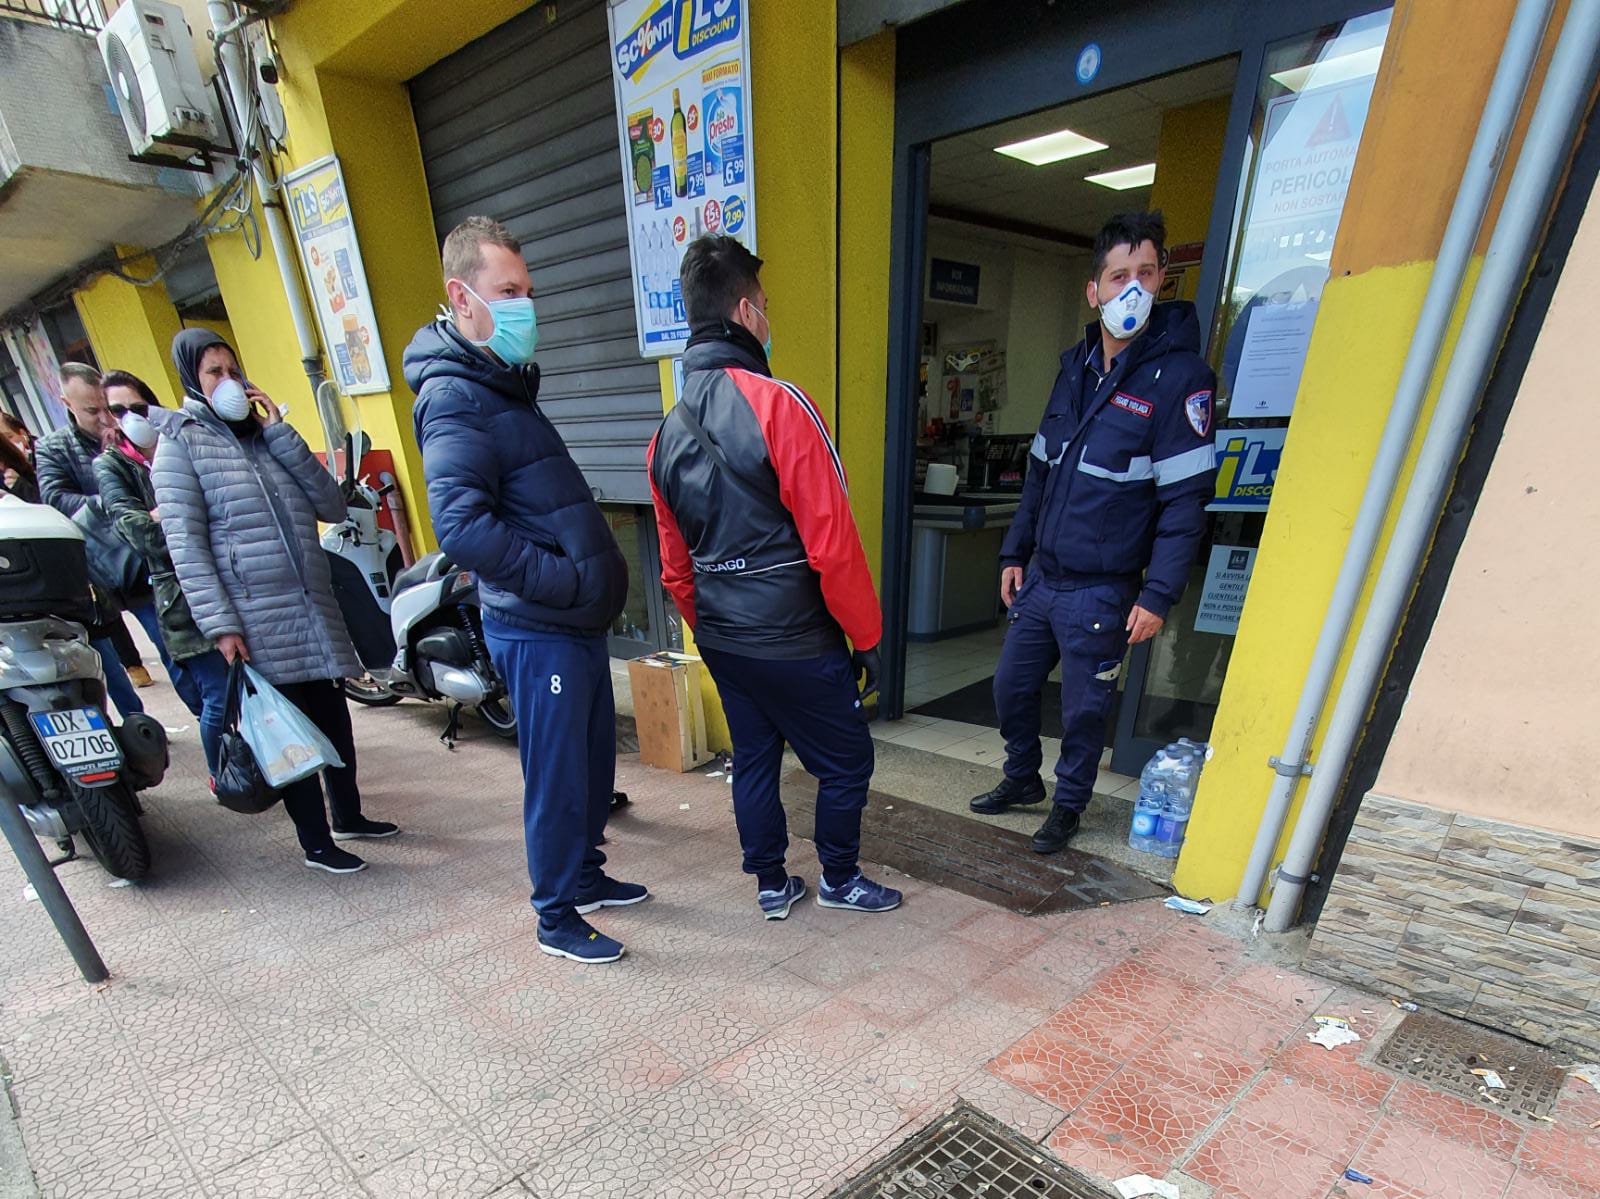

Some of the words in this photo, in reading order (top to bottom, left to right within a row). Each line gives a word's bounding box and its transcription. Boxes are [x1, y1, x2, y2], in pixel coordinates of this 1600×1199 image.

[691, 15, 736, 46] DISCOUNT
[1265, 157, 1301, 174] PORTA
[1273, 199, 1297, 213] NON
[1215, 439, 1277, 498] iL
[550, 674, 562, 694] 8
[49, 711, 80, 733] DX
[51, 734, 115, 760] 02706
[97, 759, 121, 769] MOTO
